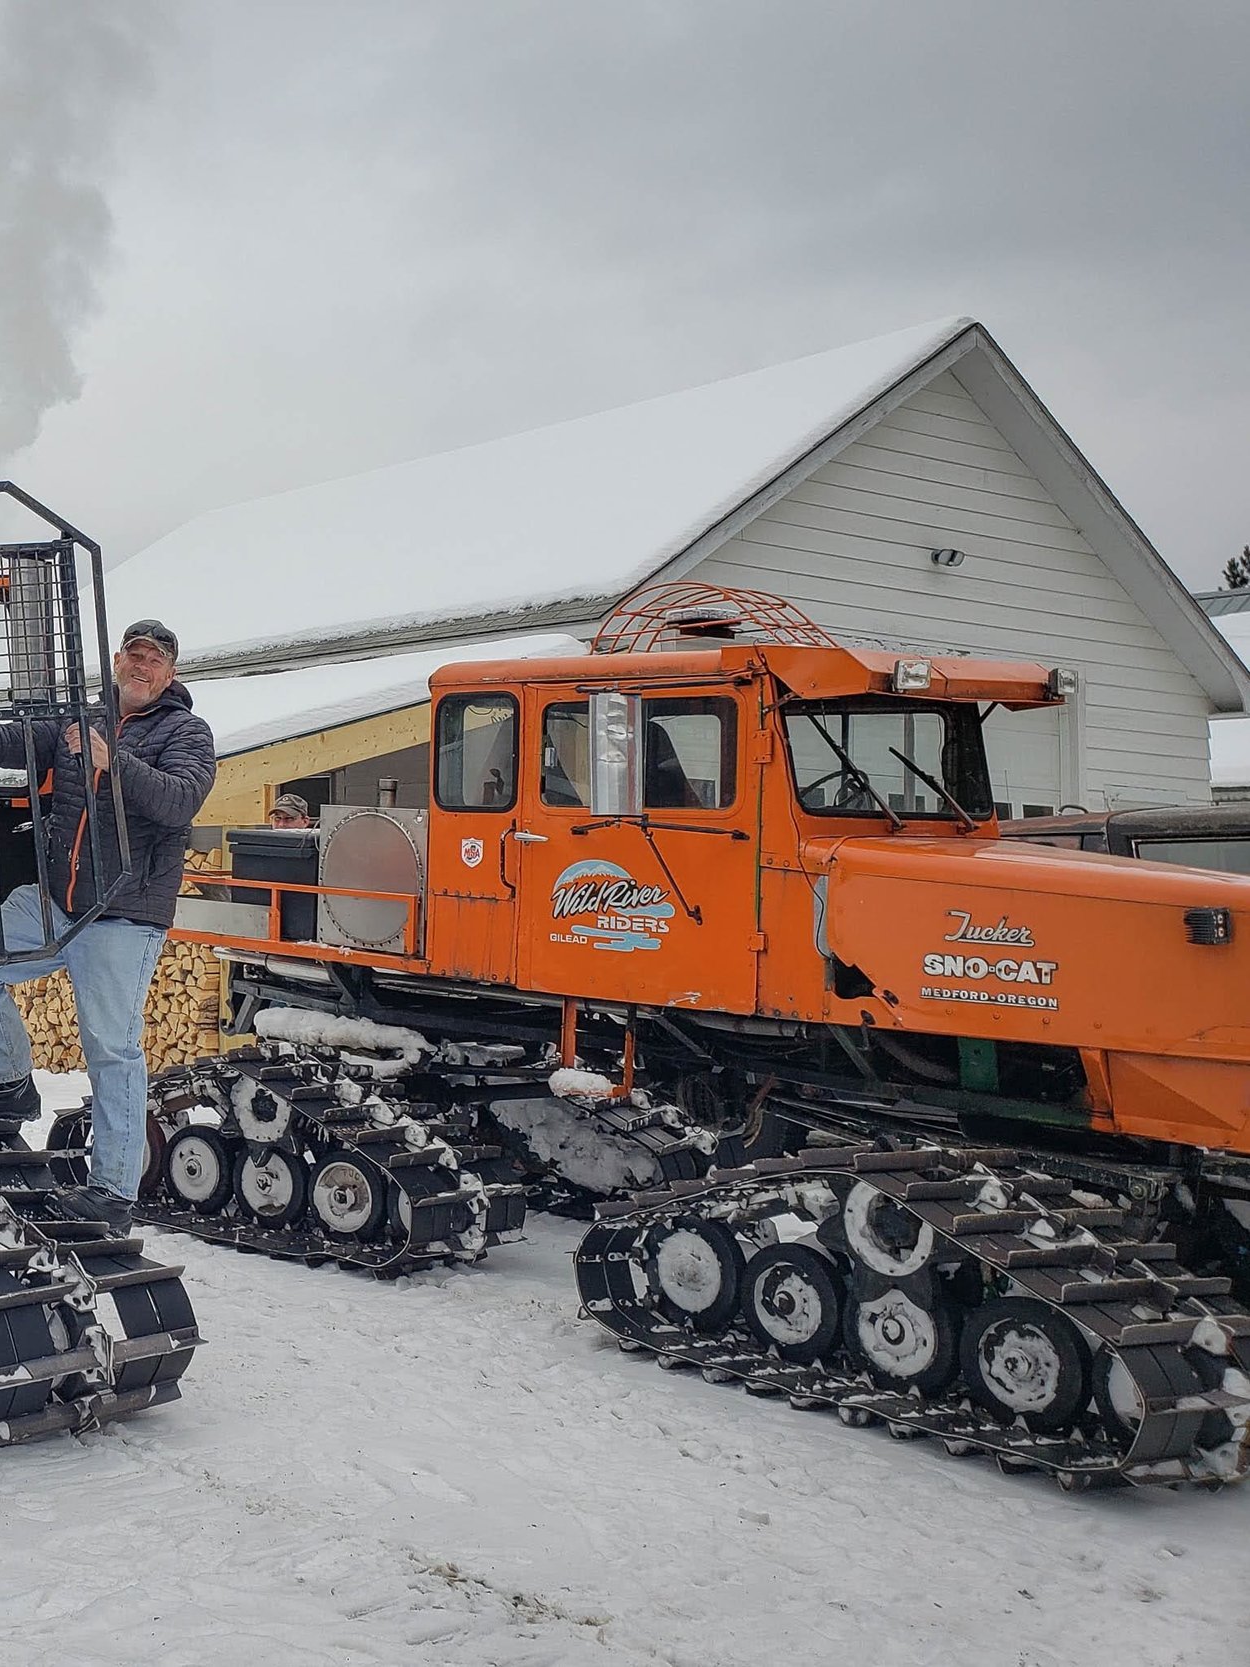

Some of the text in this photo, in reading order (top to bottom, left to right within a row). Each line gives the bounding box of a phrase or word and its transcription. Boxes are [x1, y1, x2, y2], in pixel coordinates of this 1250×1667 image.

[551, 879, 669, 918] Wild River
[549, 932, 588, 944] GILEAD
[597, 915, 670, 933] RIDERS
[944, 909, 1035, 947] Tucker
